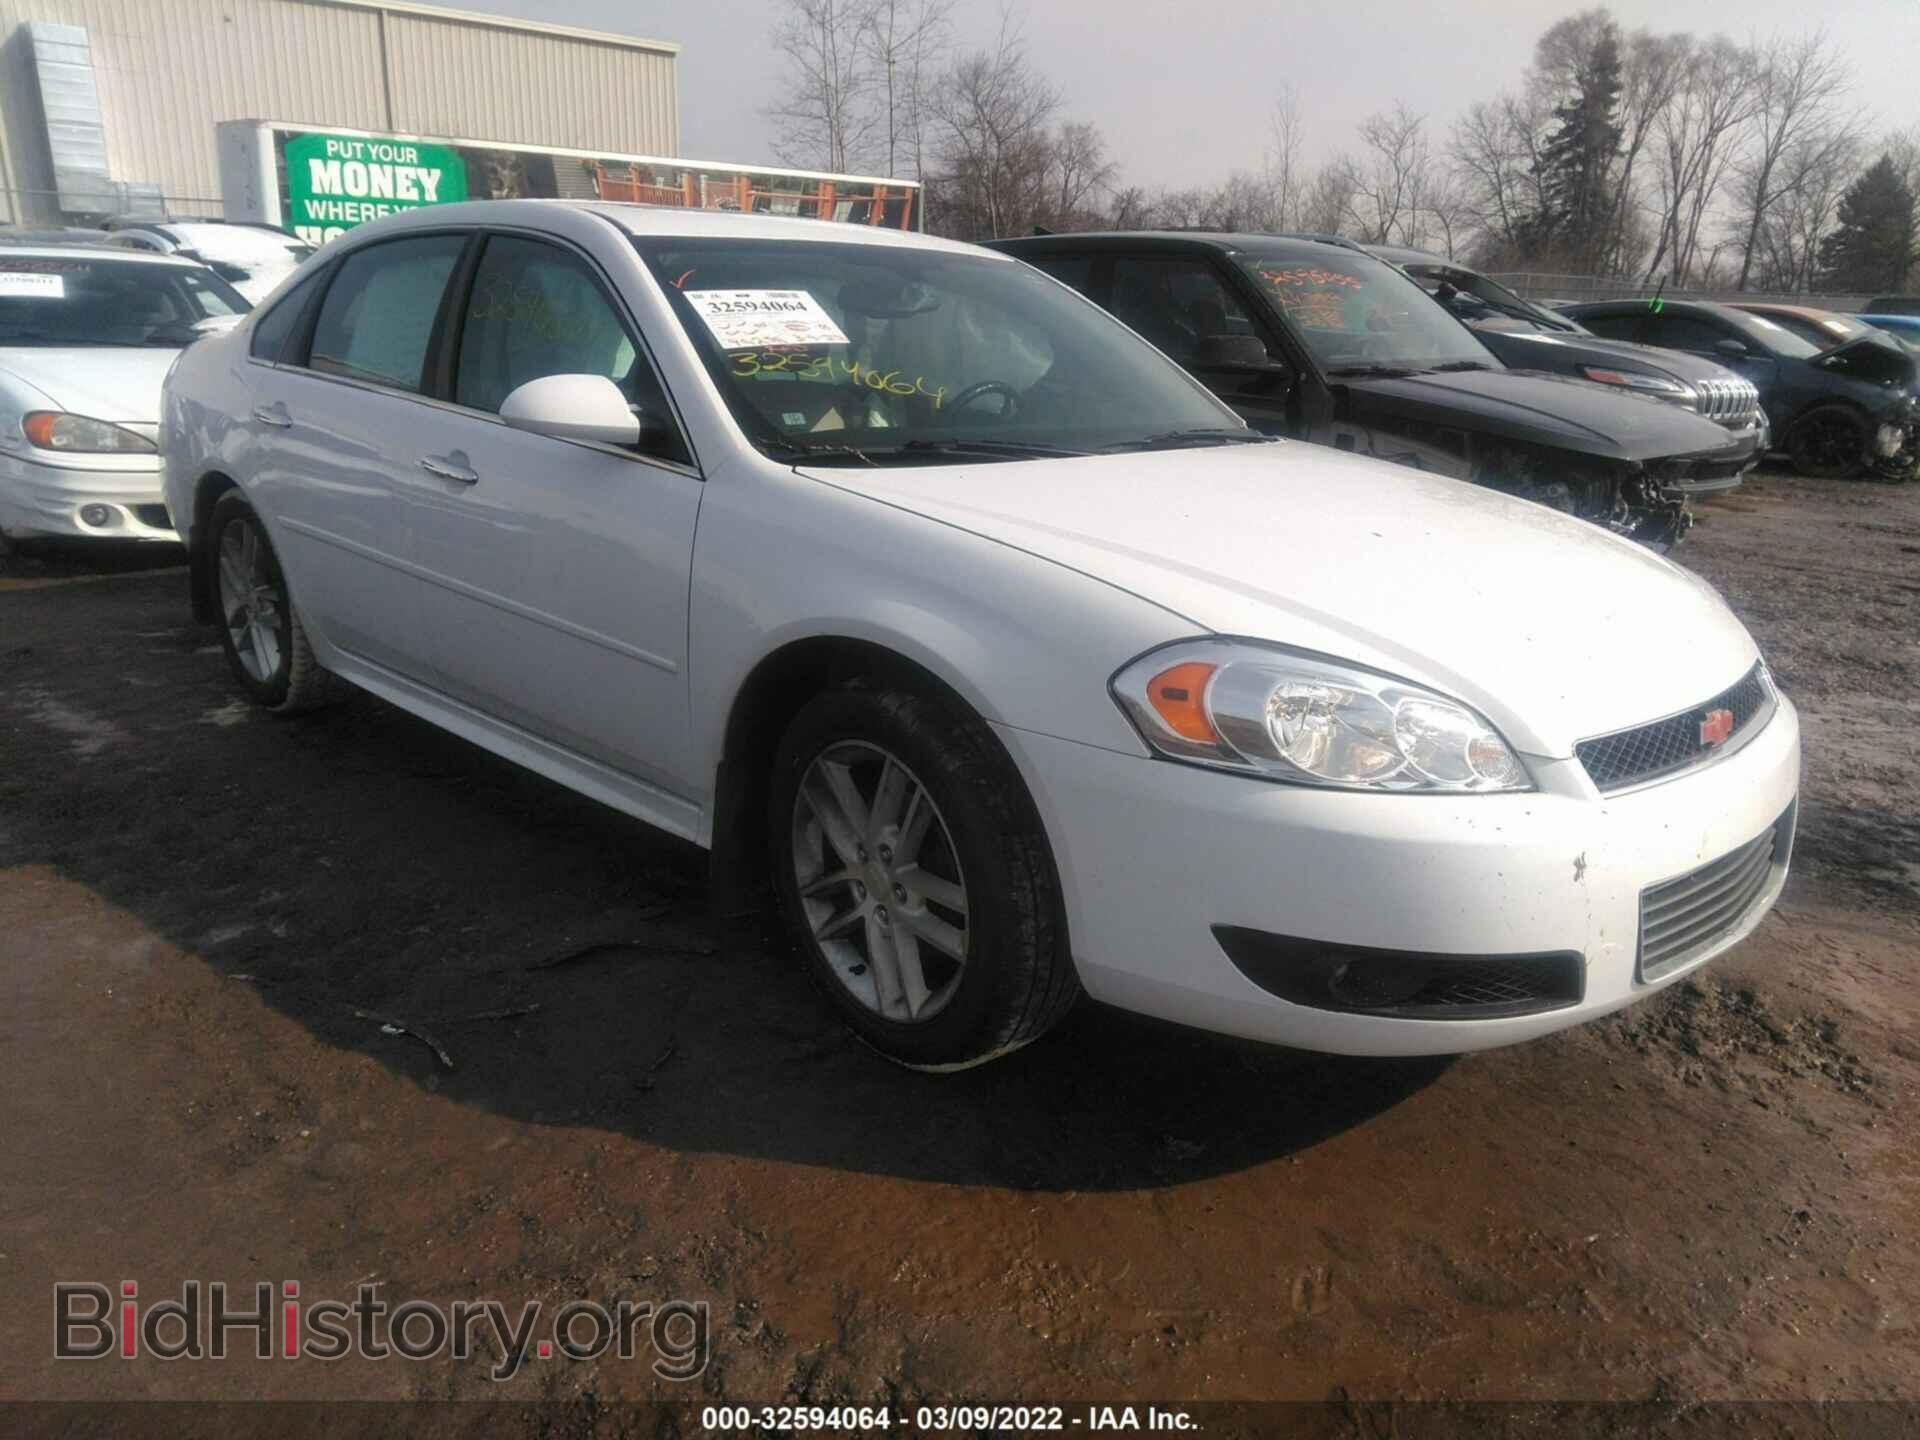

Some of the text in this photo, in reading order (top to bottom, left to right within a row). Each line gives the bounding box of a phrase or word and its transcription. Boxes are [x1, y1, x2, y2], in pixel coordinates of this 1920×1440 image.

[326, 140, 418, 164] PUT YOUR
[309, 159, 441, 202] MONEY
[706, 301, 808, 314] 32594064
[728, 352, 946, 409] 32594064
